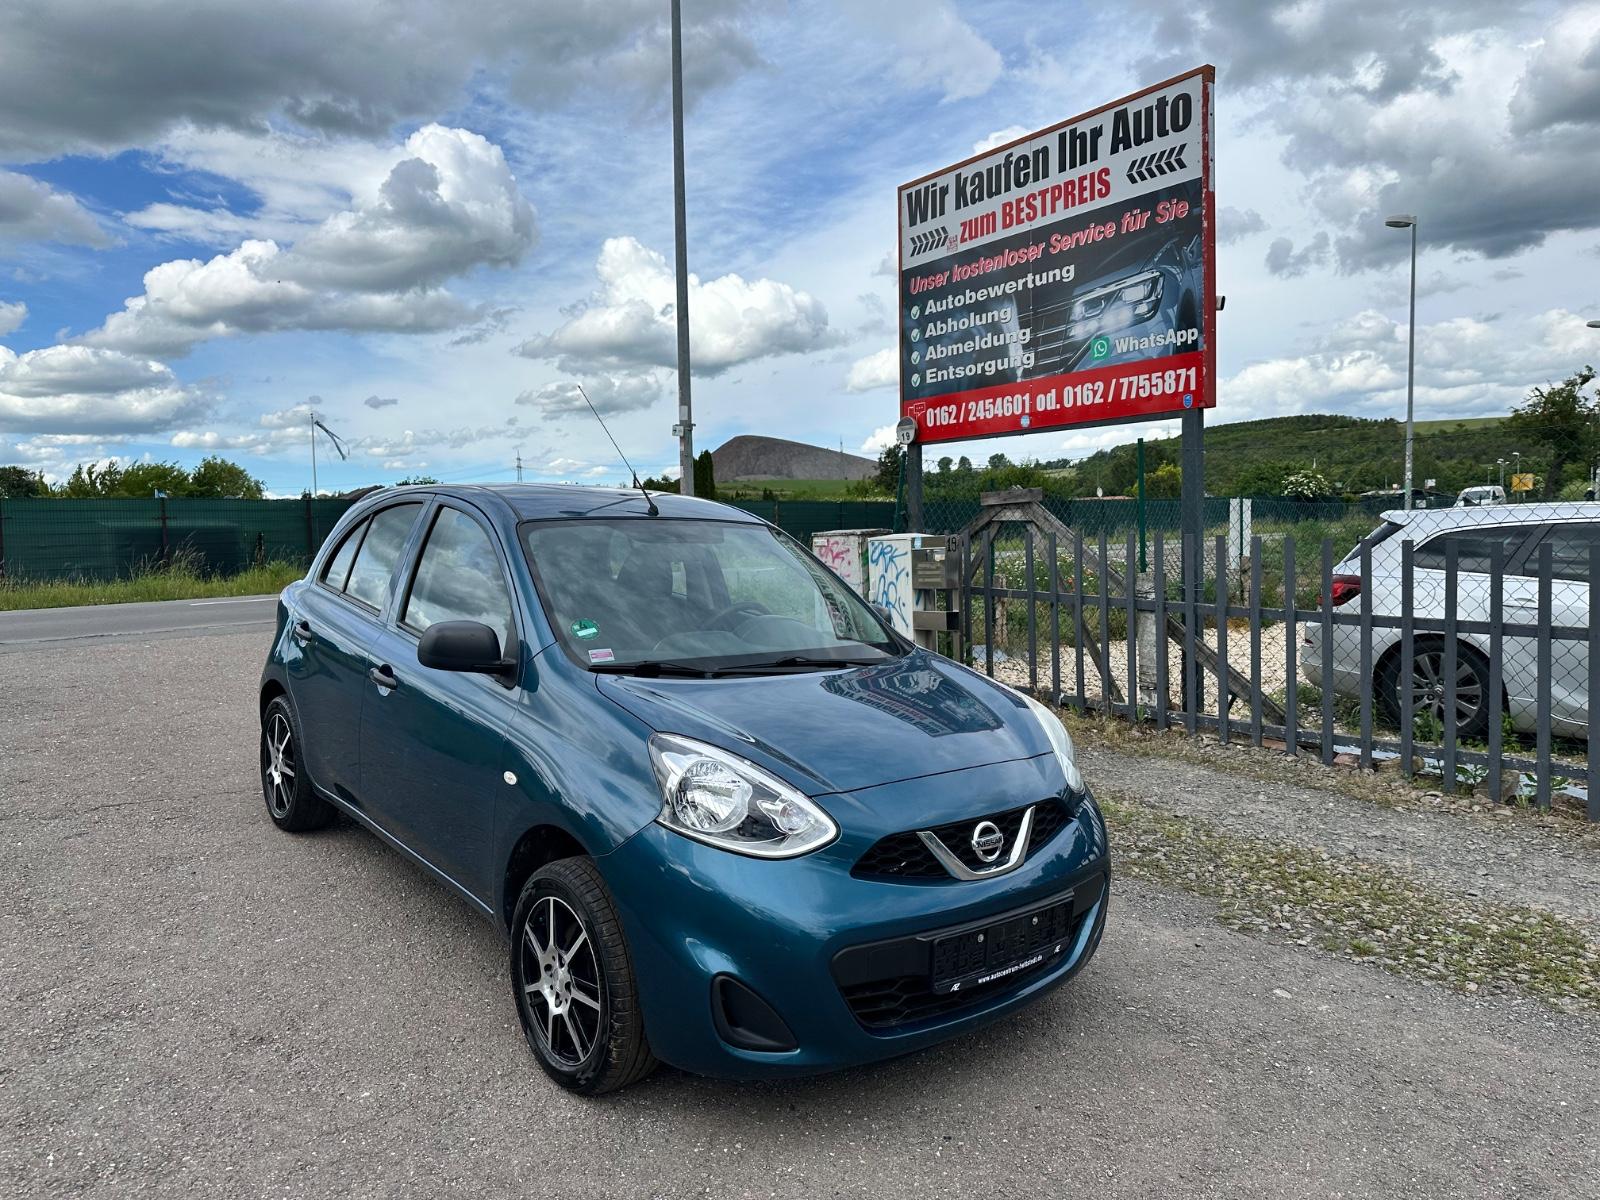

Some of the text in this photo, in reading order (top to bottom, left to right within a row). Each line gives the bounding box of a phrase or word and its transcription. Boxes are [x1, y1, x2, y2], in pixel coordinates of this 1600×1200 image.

[906, 92, 1193, 228] Wir kaufen Ihr Auto
[959, 167, 1111, 244] zum BESTPREIS
[909, 268, 950, 296] Unser
[951, 241, 1044, 287] kostenloser
[1049, 219, 1116, 255] Service
[1119, 207, 1151, 235] für
[1154, 197, 1190, 225] Sie
[924, 262, 1076, 316] Autobewertung
[924, 305, 1012, 340] Abholung
[924, 326, 1032, 362] Abmeldung
[1114, 326, 1199, 354] WhatsApp
[925, 350, 1036, 385] Entsorgung
[926, 403, 957, 428] 0162
[968, 392, 1030, 422] 2454601
[1036, 391, 1061, 412] od.
[1063, 380, 1104, 408] 0162
[1118, 366, 1198, 400] 7755871
